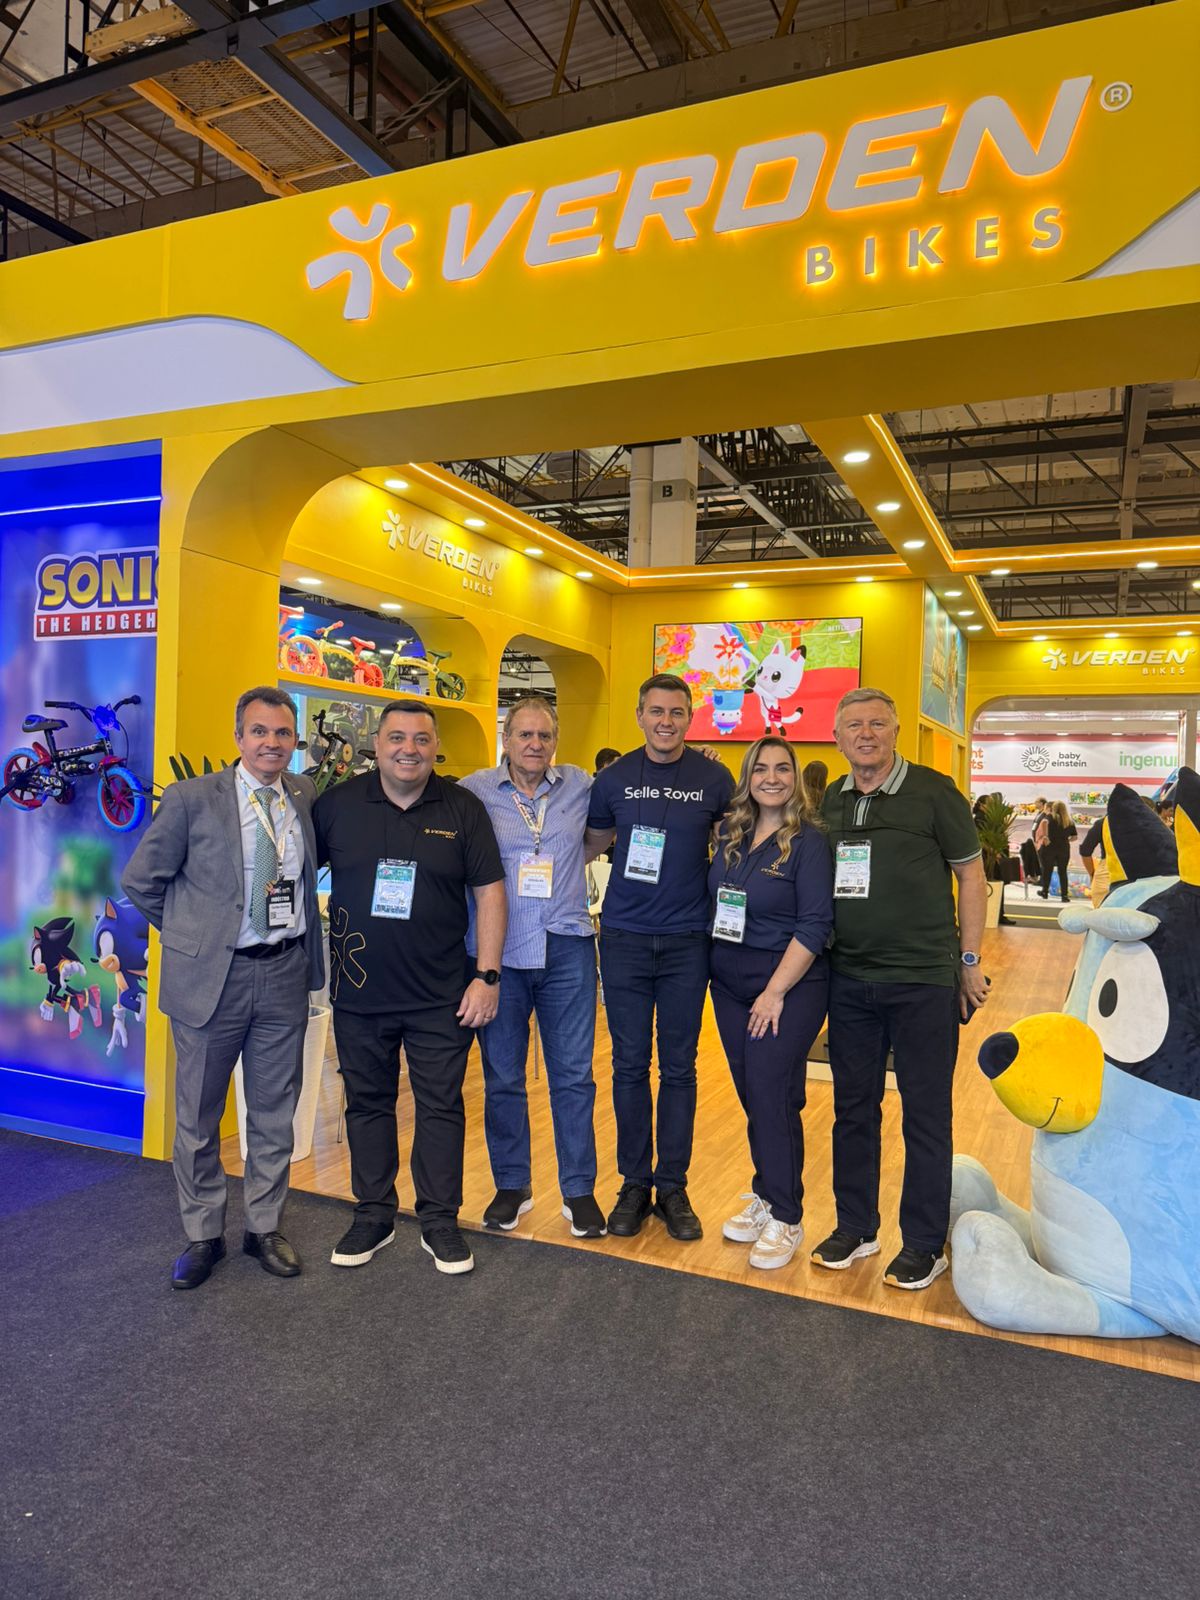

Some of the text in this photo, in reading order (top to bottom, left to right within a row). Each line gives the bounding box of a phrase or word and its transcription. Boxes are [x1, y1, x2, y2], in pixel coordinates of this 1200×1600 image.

[805, 206, 1064, 284] BIKES
[662, 485, 673, 498] B
[39, 552, 159, 610] SONI
[462, 576, 493, 598] BIKES
[38, 617, 72, 634] THE
[1142, 666, 1186, 676] BIKES
[1051, 760, 1087, 768] einstein
[1058, 751, 1081, 760] baby
[624, 785, 704, 803] Selle Royal
